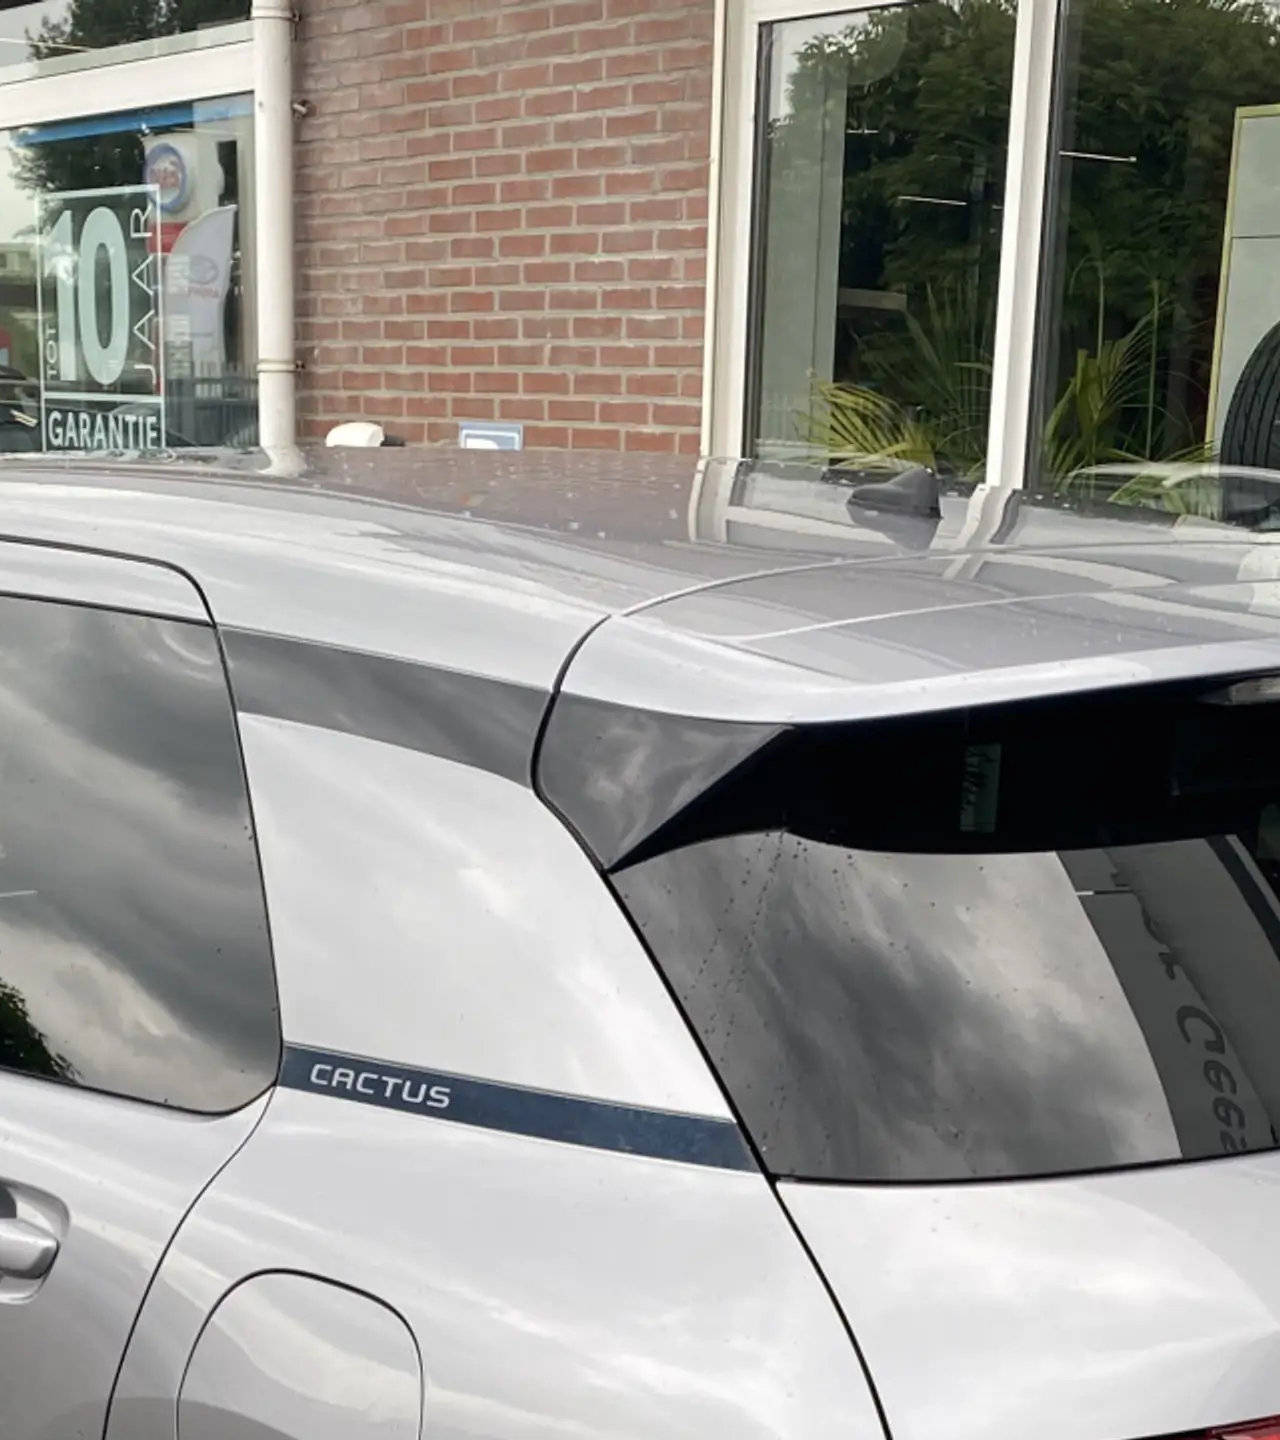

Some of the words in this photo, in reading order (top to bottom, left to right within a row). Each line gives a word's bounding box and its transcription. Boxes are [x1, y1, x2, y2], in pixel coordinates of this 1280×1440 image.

[44, 205, 130, 385] 10
[129, 203, 158, 386] JAAR
[45, 326, 58, 381] TOT
[47, 410, 160, 450] GARANTIE
[309, 1063, 452, 1109] CACTUS
